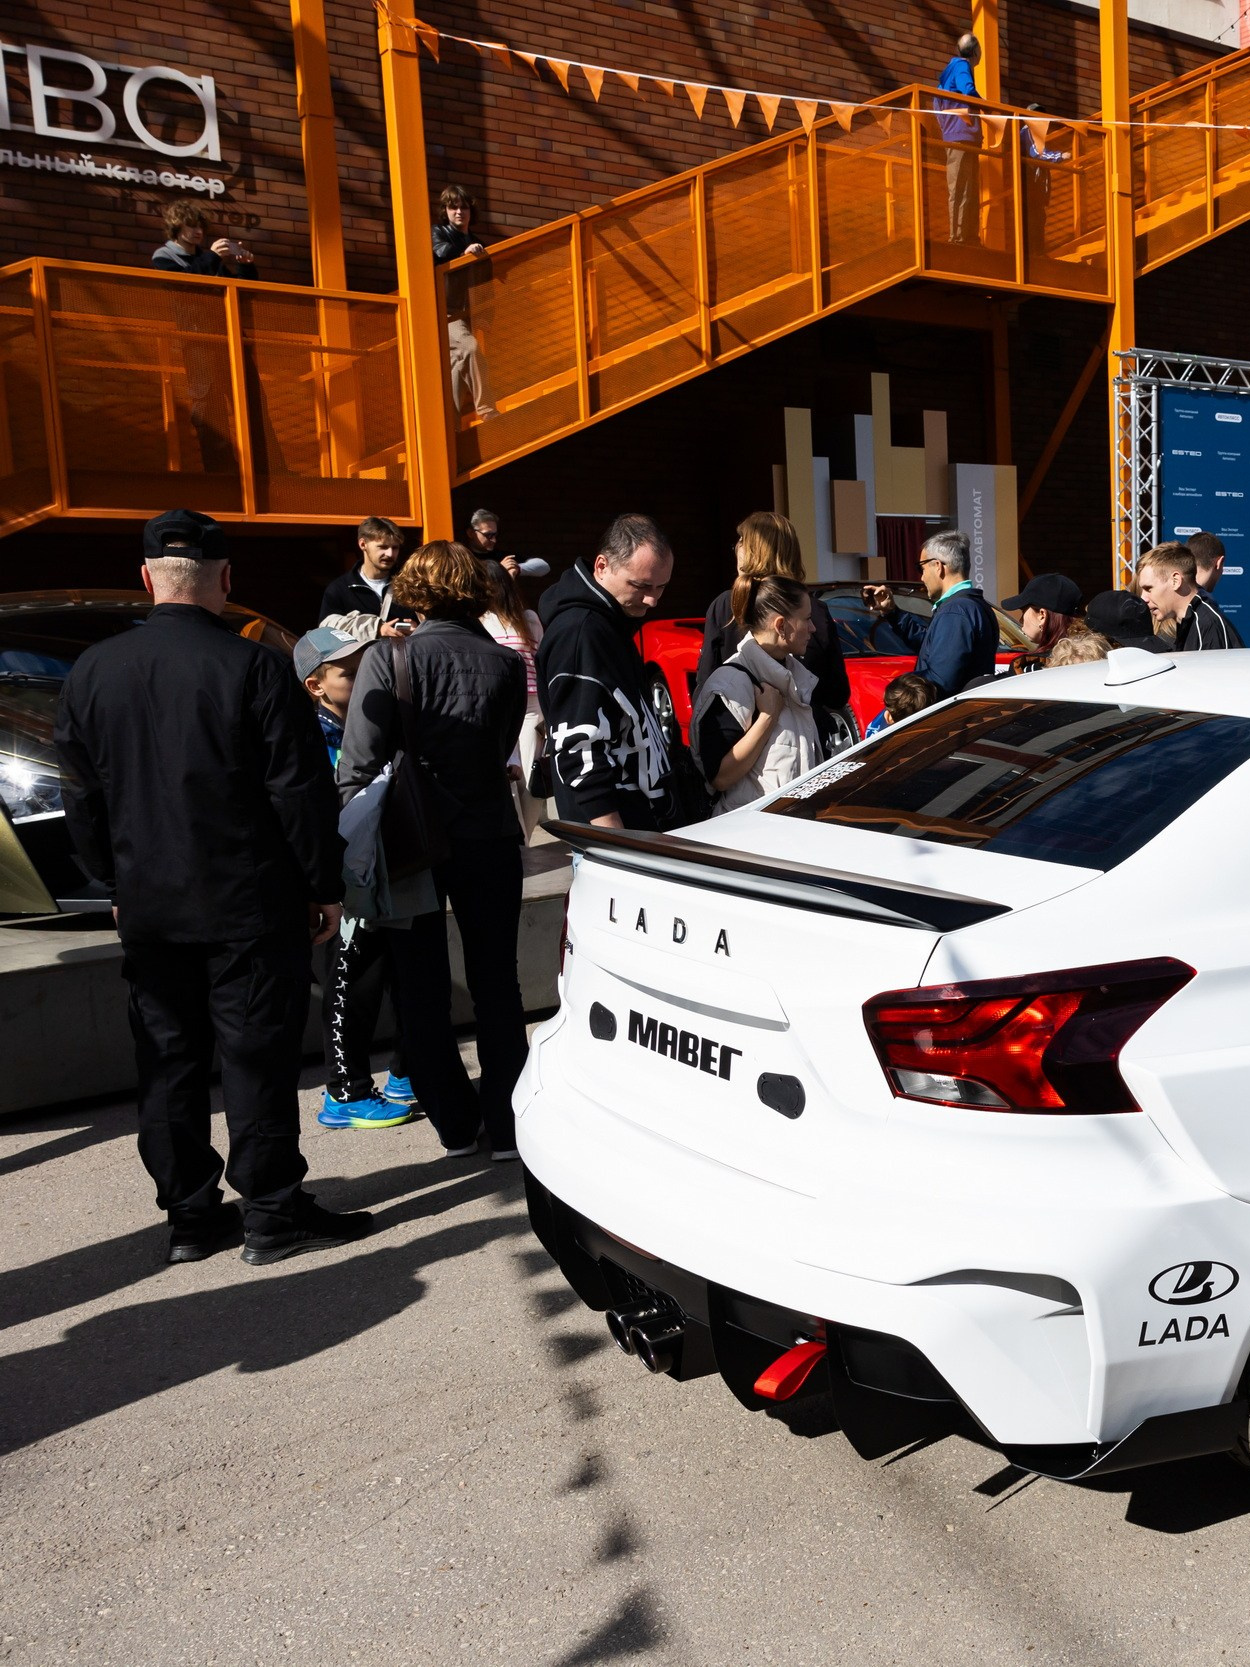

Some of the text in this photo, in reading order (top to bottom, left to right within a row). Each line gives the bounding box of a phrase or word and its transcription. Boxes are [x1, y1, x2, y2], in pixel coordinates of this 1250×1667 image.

[105, 162, 226, 199] кластер
[608, 897, 732, 957] LADA
[1138, 1313, 1231, 1347] LADA
